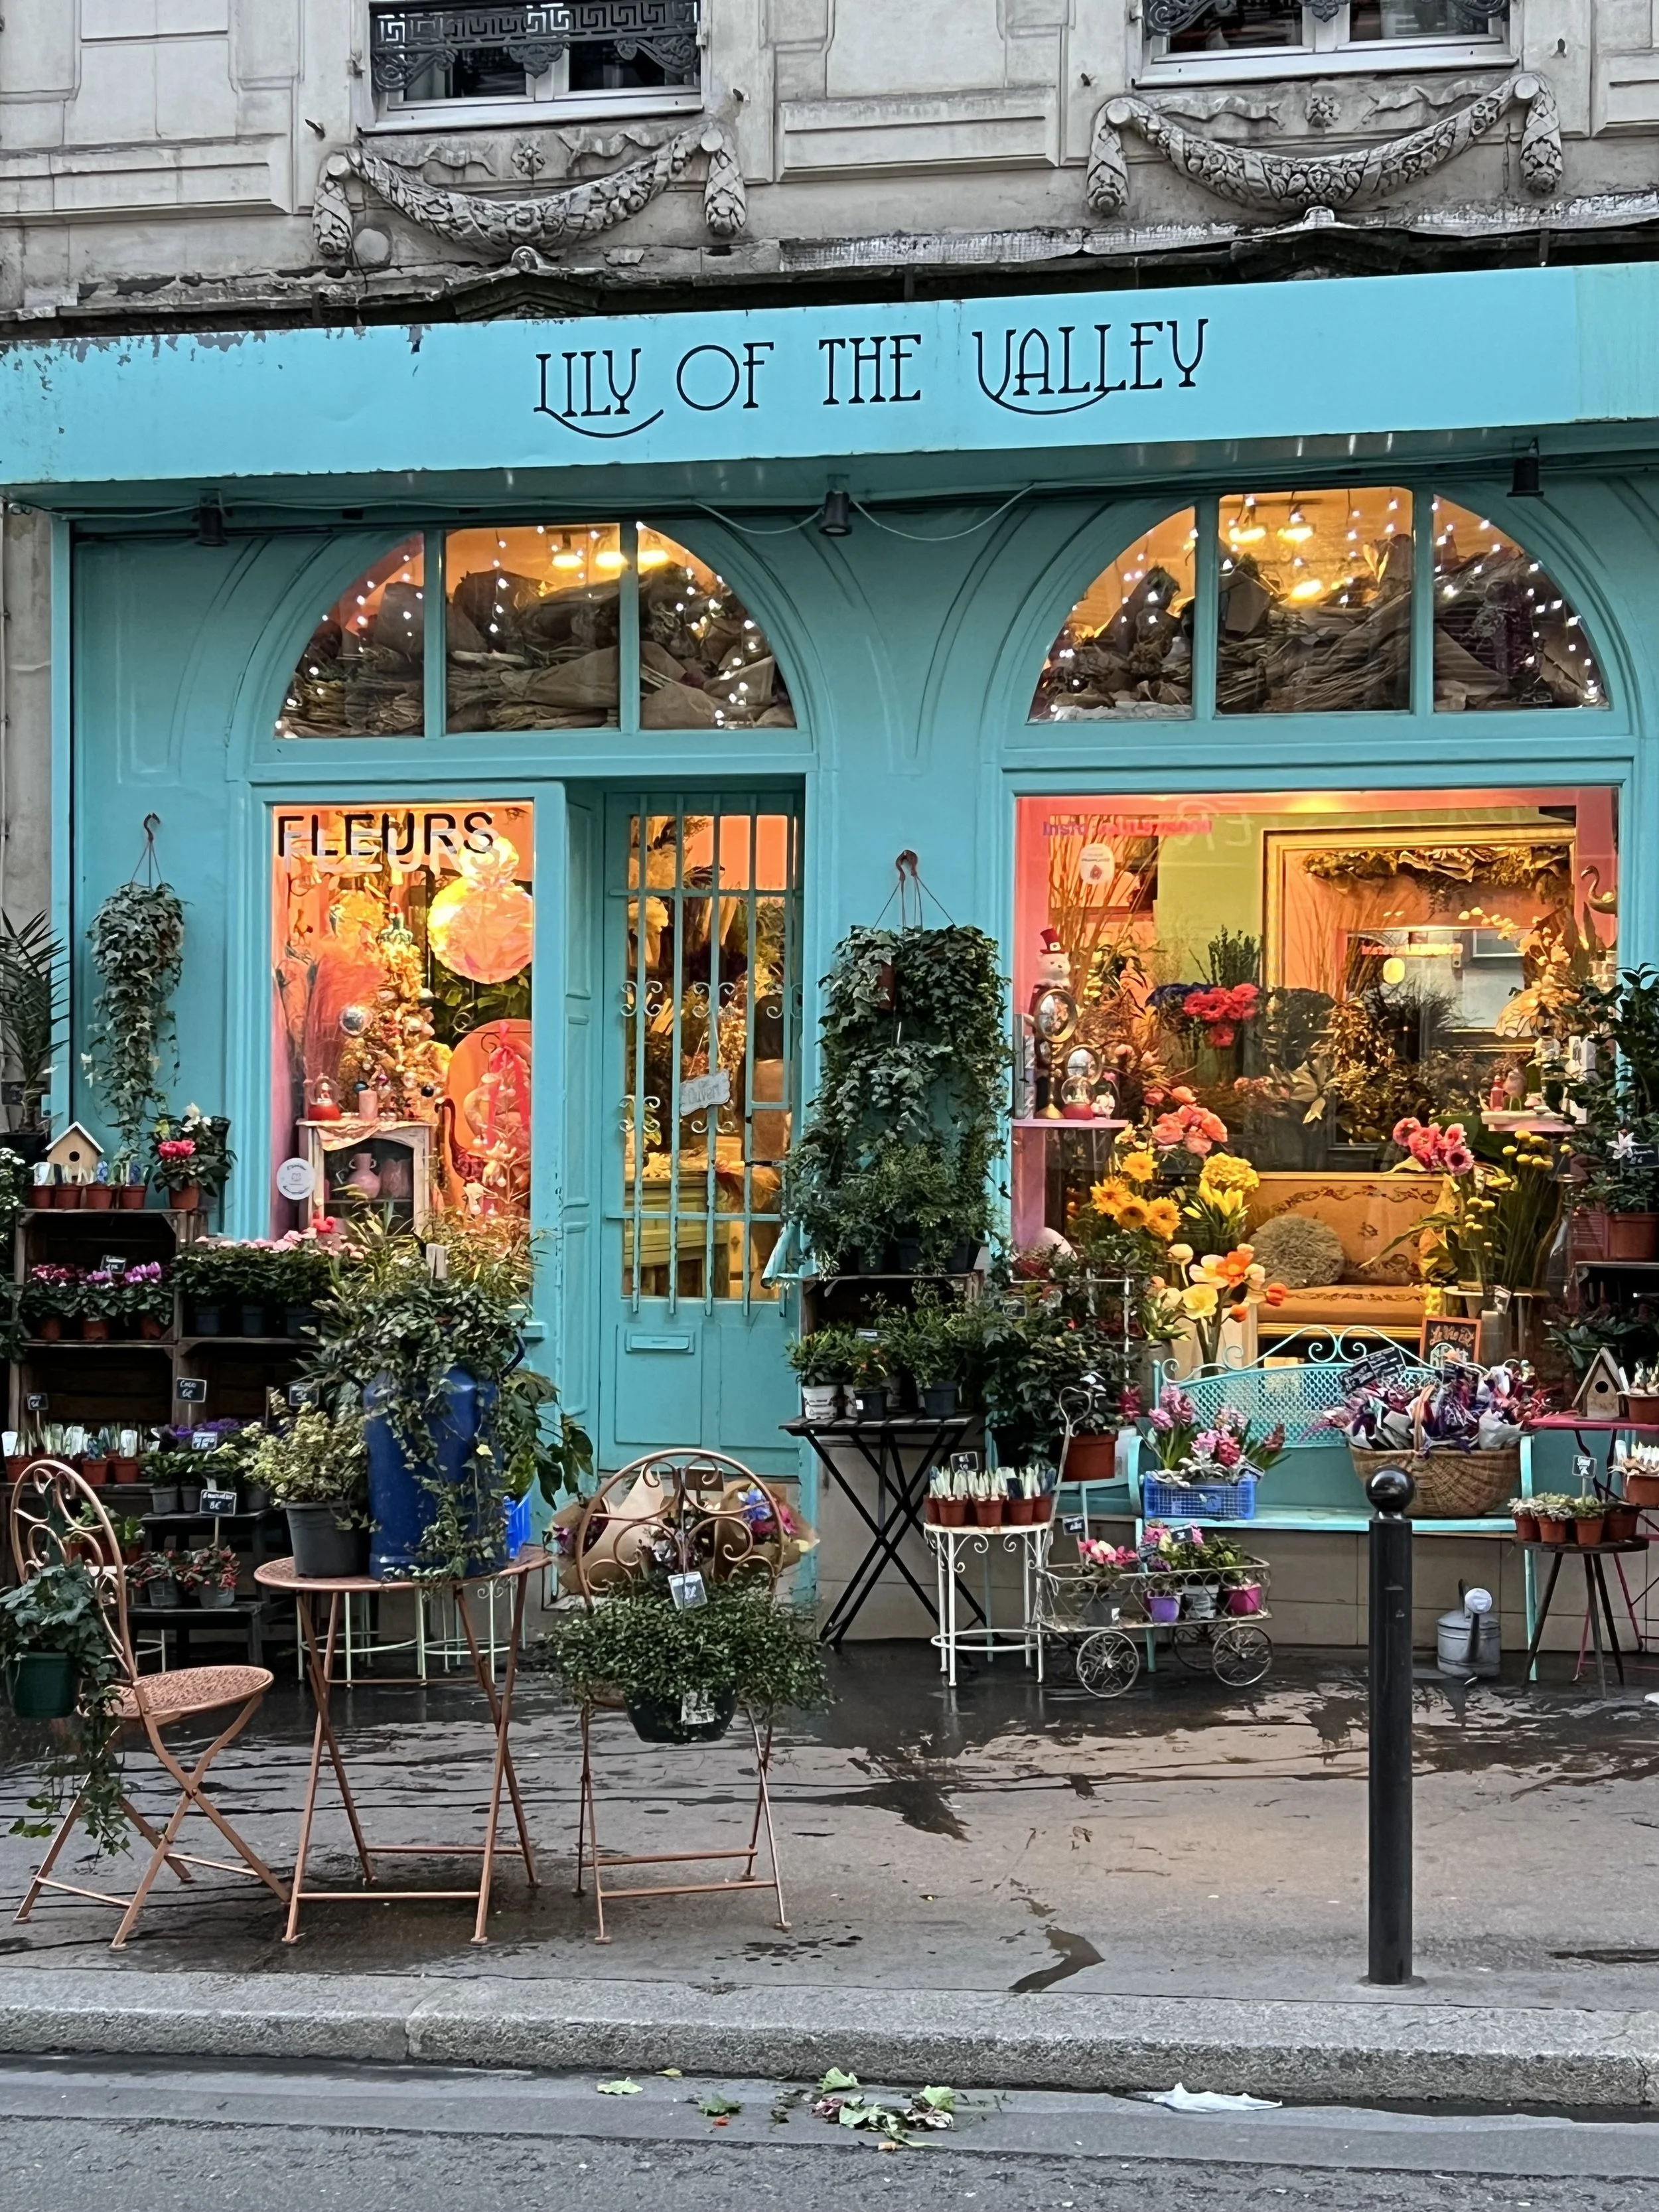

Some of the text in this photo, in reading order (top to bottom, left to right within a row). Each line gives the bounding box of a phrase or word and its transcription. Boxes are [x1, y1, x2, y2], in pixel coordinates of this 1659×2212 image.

[534, 319, 1209, 439] LILY OF THE VALLEY
[278, 811, 493, 857] FLEURS
